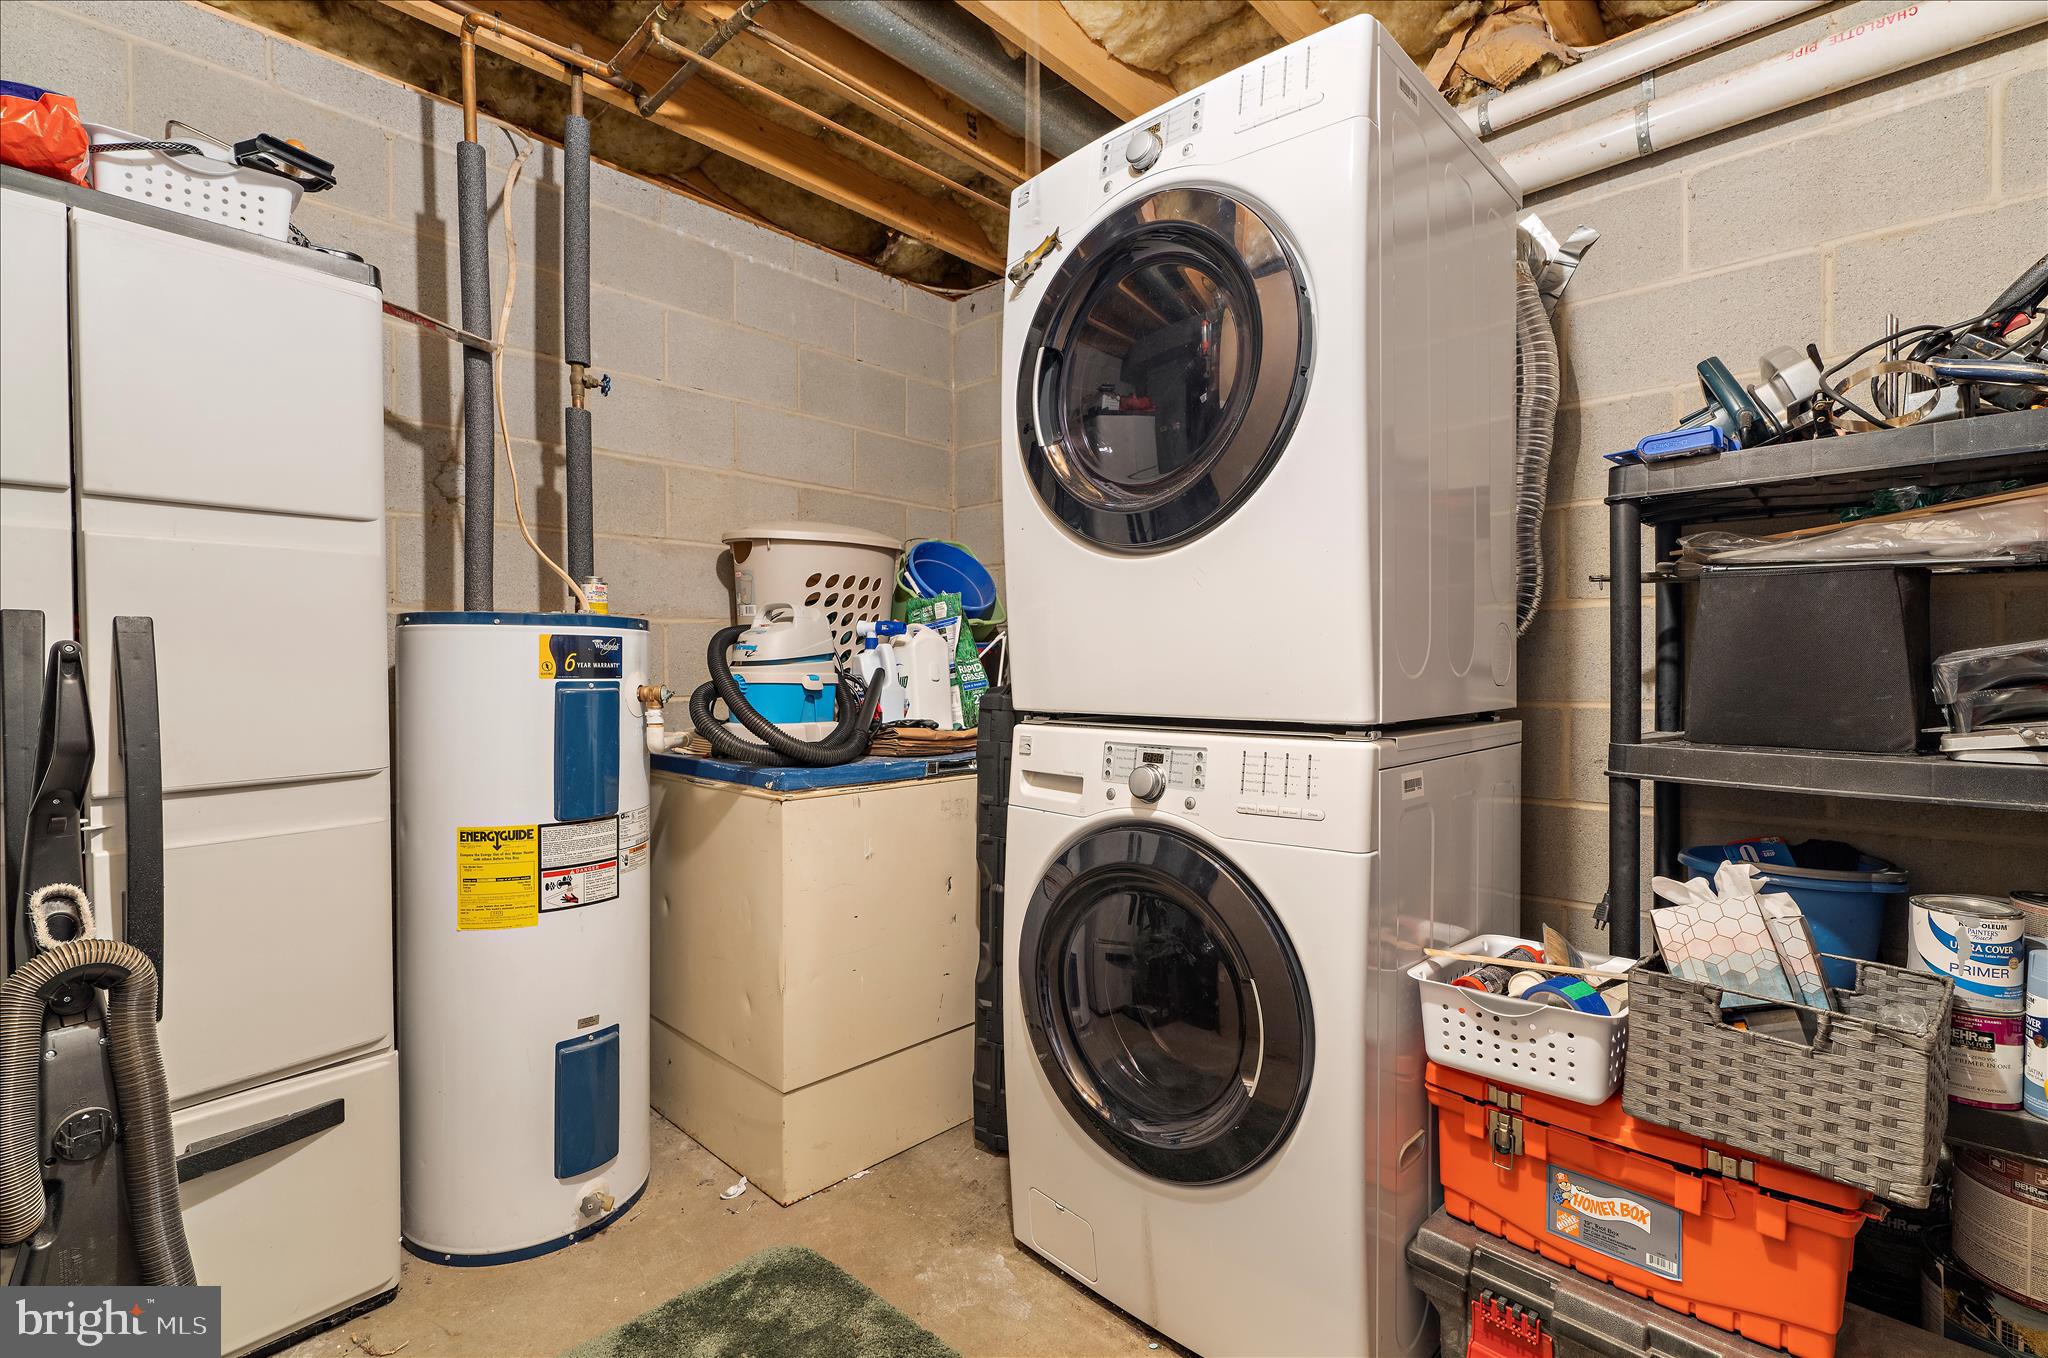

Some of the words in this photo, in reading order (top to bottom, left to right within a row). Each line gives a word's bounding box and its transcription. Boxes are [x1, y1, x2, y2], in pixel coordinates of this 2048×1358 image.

[1828, 6, 1919, 46] CHARLOTTE
[1785, 40, 1819, 61] PIPE
[564, 653, 577, 672] 6
[958, 663, 982, 673] RAPID
[961, 672, 985, 681] GRASS
[460, 829, 534, 843] ENERGYGUIDE
[575, 865, 600, 873] DANGER
[1985, 945, 2013, 954] COVER
[1949, 962, 2009, 979] PRIMER
[1951, 1027, 1978, 1042] EHR
[2014, 1180, 2038, 1195] BEHR
[1573, 1192, 1619, 1217] HOMER
[1620, 1202, 1651, 1225] BOX
[1556, 1214, 1577, 1231] HOME
[1607, 1228, 1620, 1237] Box
